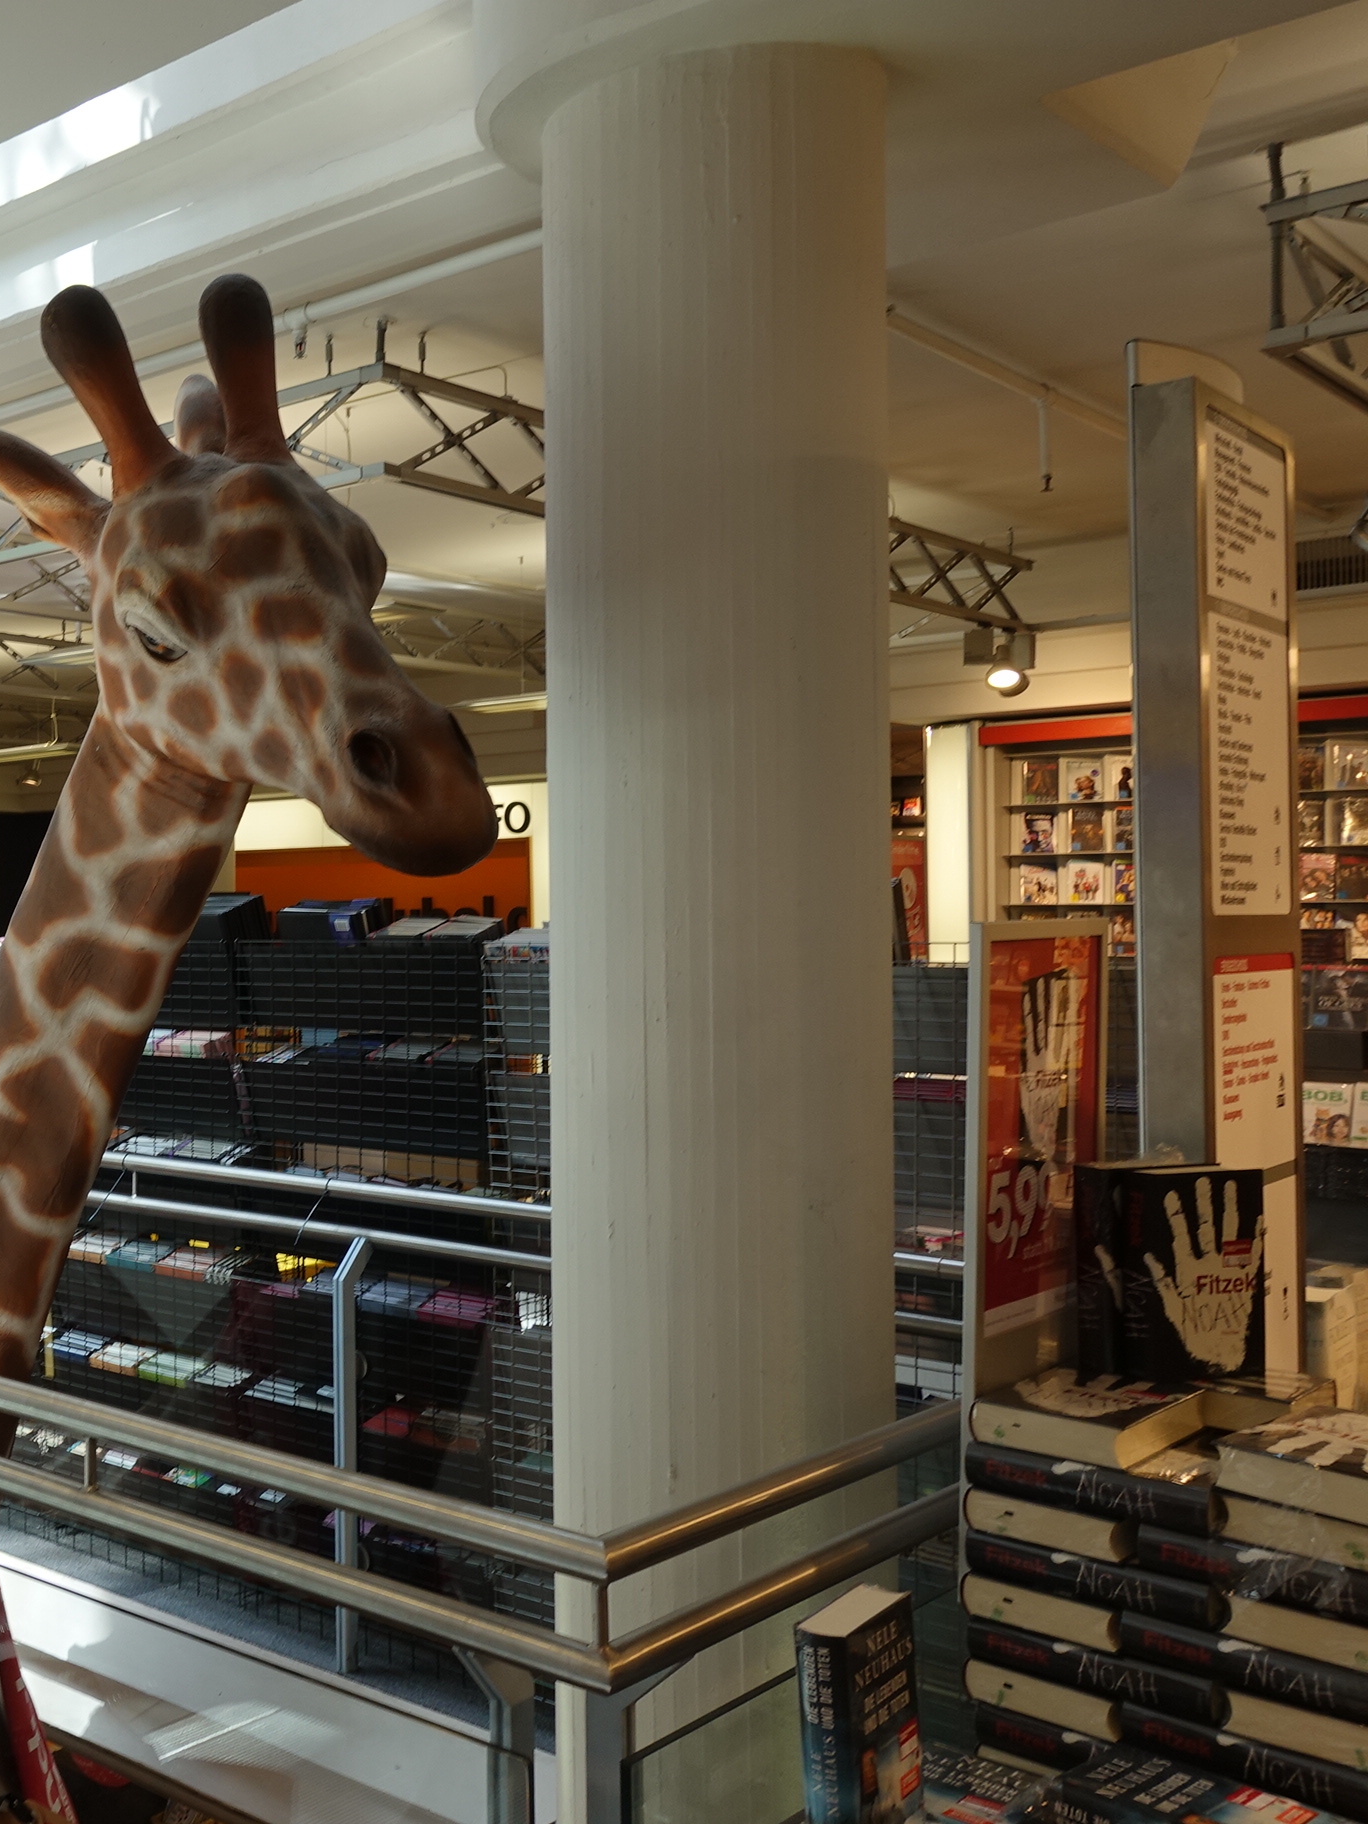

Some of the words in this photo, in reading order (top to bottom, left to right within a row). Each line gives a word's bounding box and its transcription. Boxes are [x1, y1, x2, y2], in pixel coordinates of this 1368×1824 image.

[987, 1161, 1058, 1260] 5,99
[1196, 1273, 1257, 1295] Fitzek
[985, 1458, 1048, 1487] Fitzek
[1075, 1472, 1157, 1519] NOAH
[985, 1546, 1048, 1575] Fitzek
[1160, 1543, 1230, 1574] Fitzek
[1075, 1563, 1157, 1611] NOAH
[866, 1619, 899, 1657] NELE
[1143, 1629, 1212, 1665] Fitzek
[854, 1636, 914, 1693] NEUHAUS
[1077, 1652, 1159, 1703] NOAH
[1244, 1653, 1335, 1708] NOAH
[823, 1735, 840, 1818] NEUHAUS
[1243, 1747, 1334, 1804] NOAH
